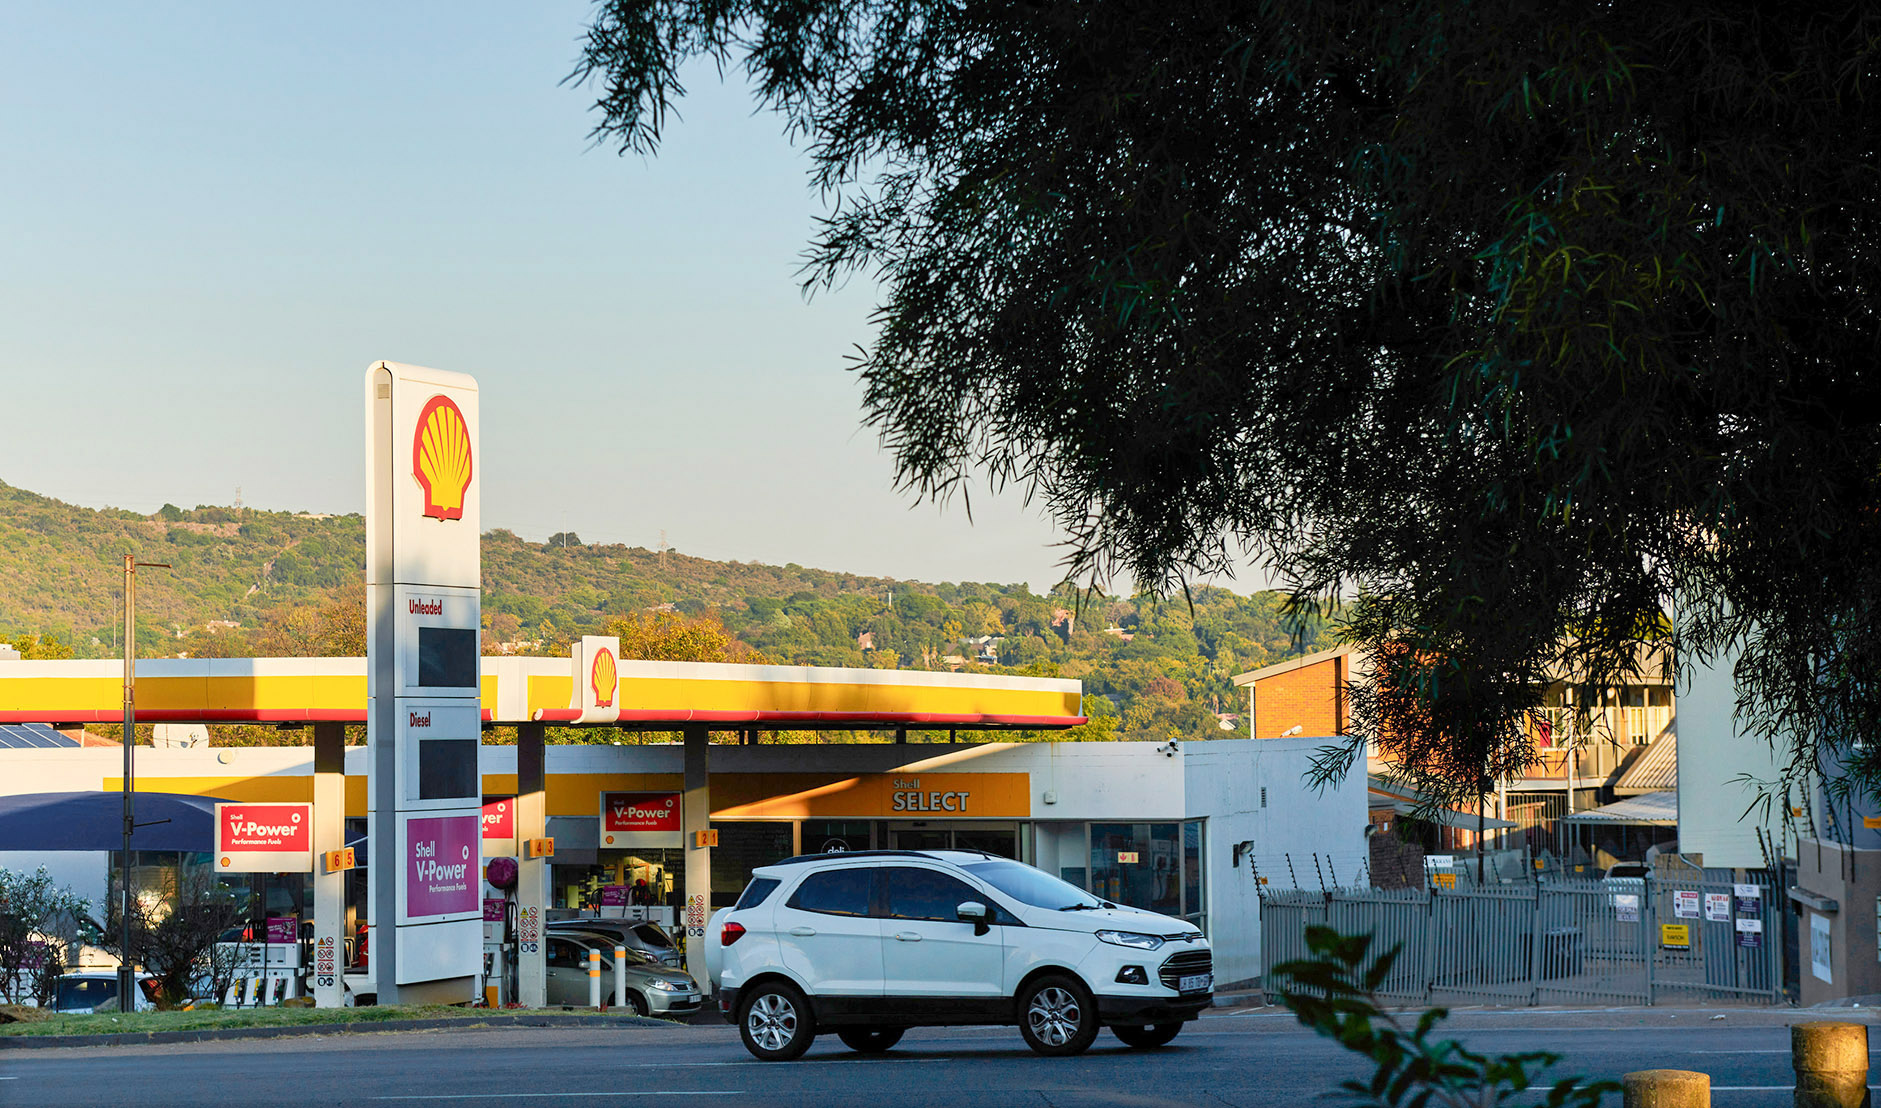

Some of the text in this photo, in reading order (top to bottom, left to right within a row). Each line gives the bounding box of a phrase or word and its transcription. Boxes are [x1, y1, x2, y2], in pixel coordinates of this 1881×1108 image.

[409, 598, 442, 615] Unleaded
[410, 711, 431, 728] Diesel
[893, 778, 920, 789] Shell
[892, 791, 970, 812] SELECT
[614, 806, 671, 819] V-Power
[230, 822, 298, 836] V-Power
[702, 833, 707, 844] 2
[712, 832, 716, 844] 1
[415, 840, 436, 858] Shell
[536, 841, 542, 853] 4
[547, 841, 553, 853] 3
[334, 854, 340, 867] 6
[347, 852, 353, 865] 5
[416, 860, 467, 882] V-Power
[429, 882, 467, 893] Performance Fuels
